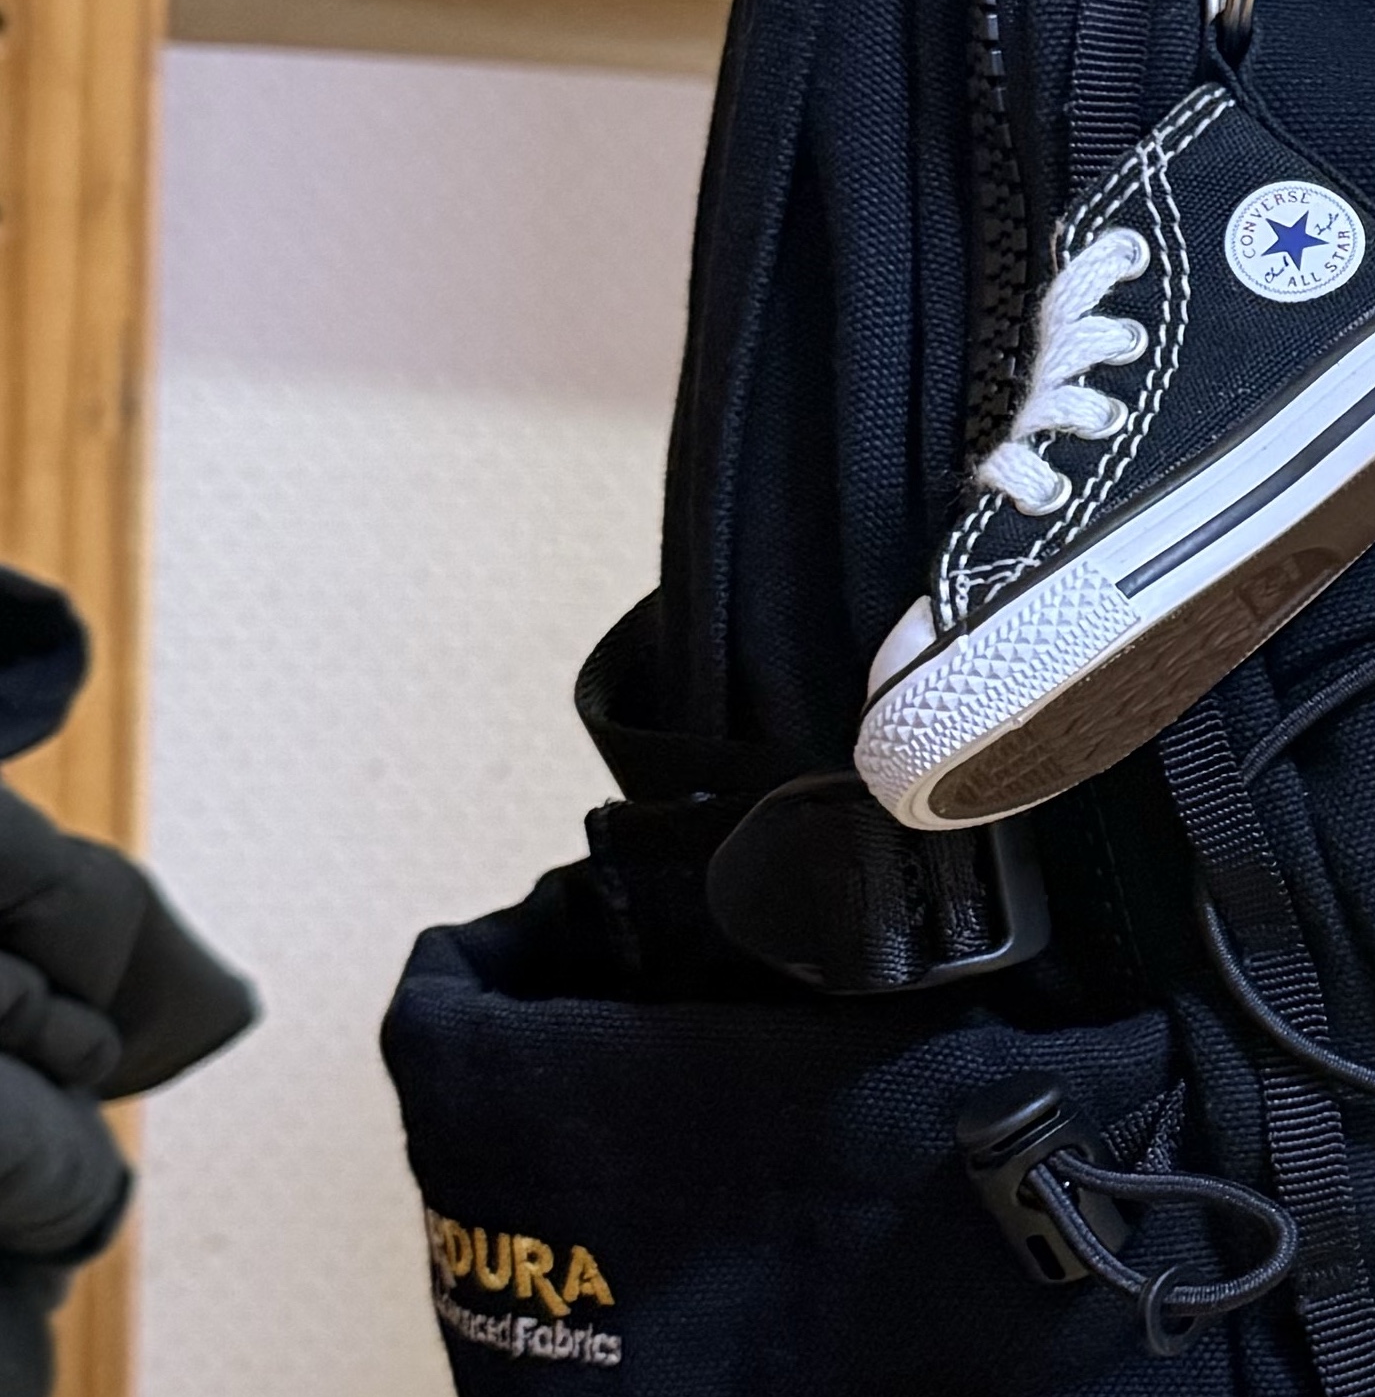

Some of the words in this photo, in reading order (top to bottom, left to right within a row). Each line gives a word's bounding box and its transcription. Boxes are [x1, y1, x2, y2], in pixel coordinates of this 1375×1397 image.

[1240, 190, 1312, 259] CONVERSE
[1287, 272, 1322, 288] ALL
[1323, 230, 1351, 273] STAR
[511, 1315, 622, 1367] Fabrics
